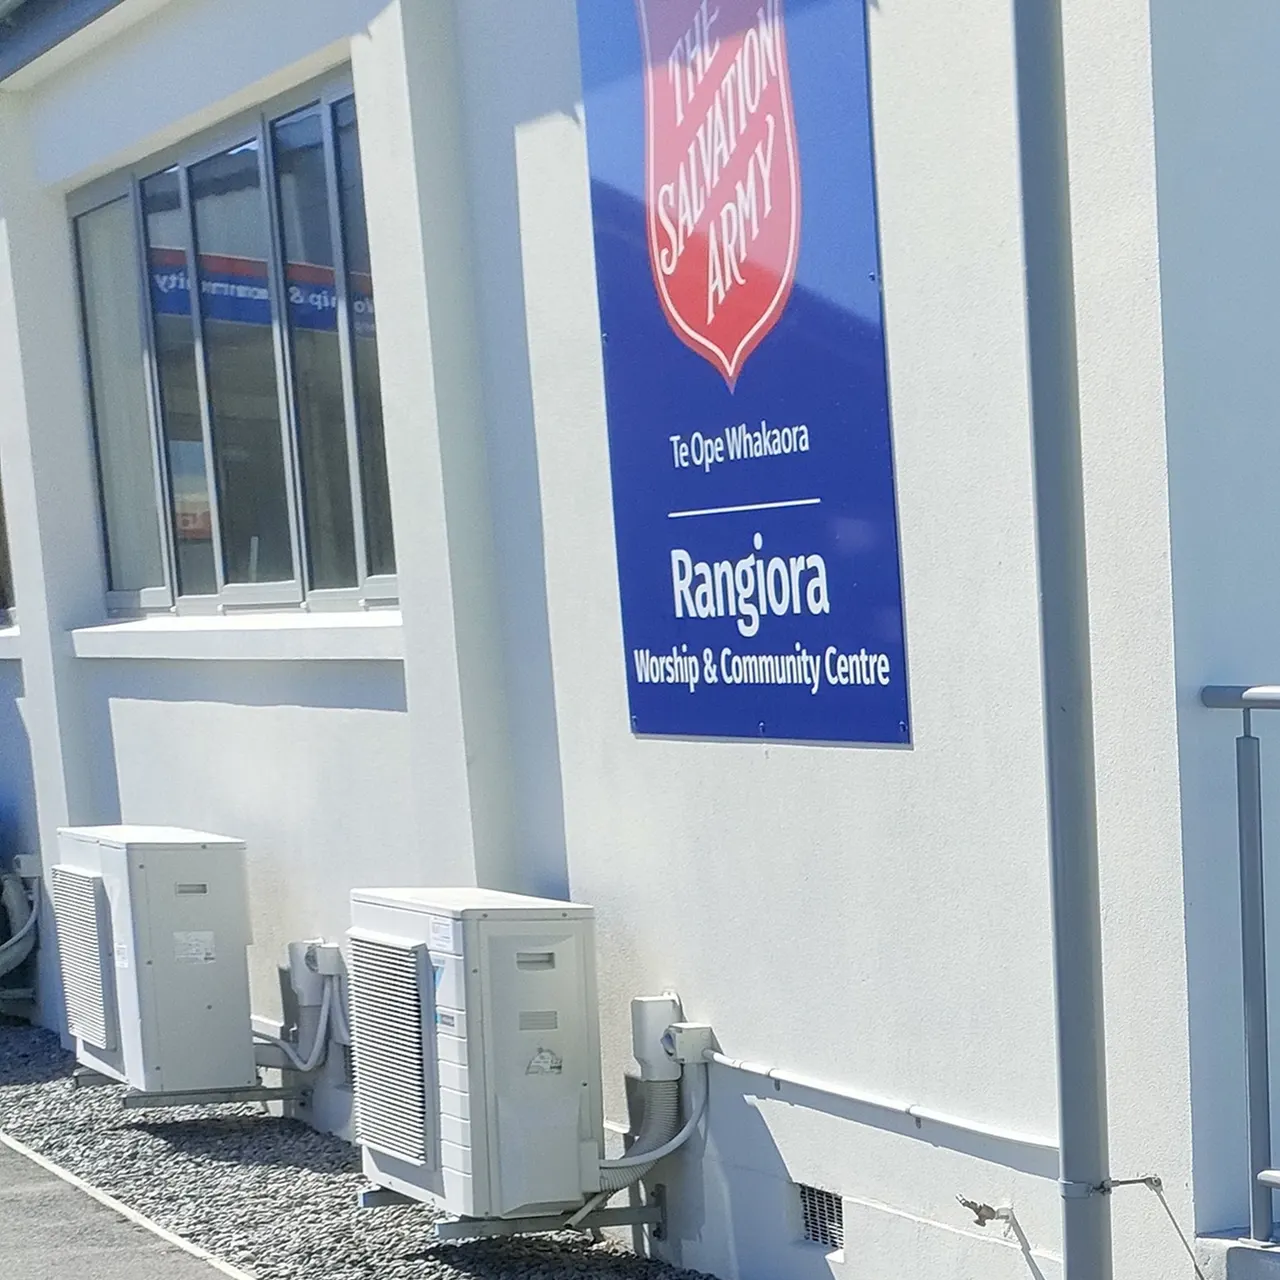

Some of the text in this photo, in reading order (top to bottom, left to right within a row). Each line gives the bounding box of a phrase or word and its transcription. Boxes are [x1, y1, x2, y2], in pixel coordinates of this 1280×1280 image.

[668, 0, 720, 127] THE
[658, 0, 777, 275] SALVATION
[706, 113, 775, 325] ARMY
[669, 420, 810, 472] Te Ope Whakaora
[670, 532, 830, 638] Rangiora
[634, 642, 890, 694] Worship & Community Centre
